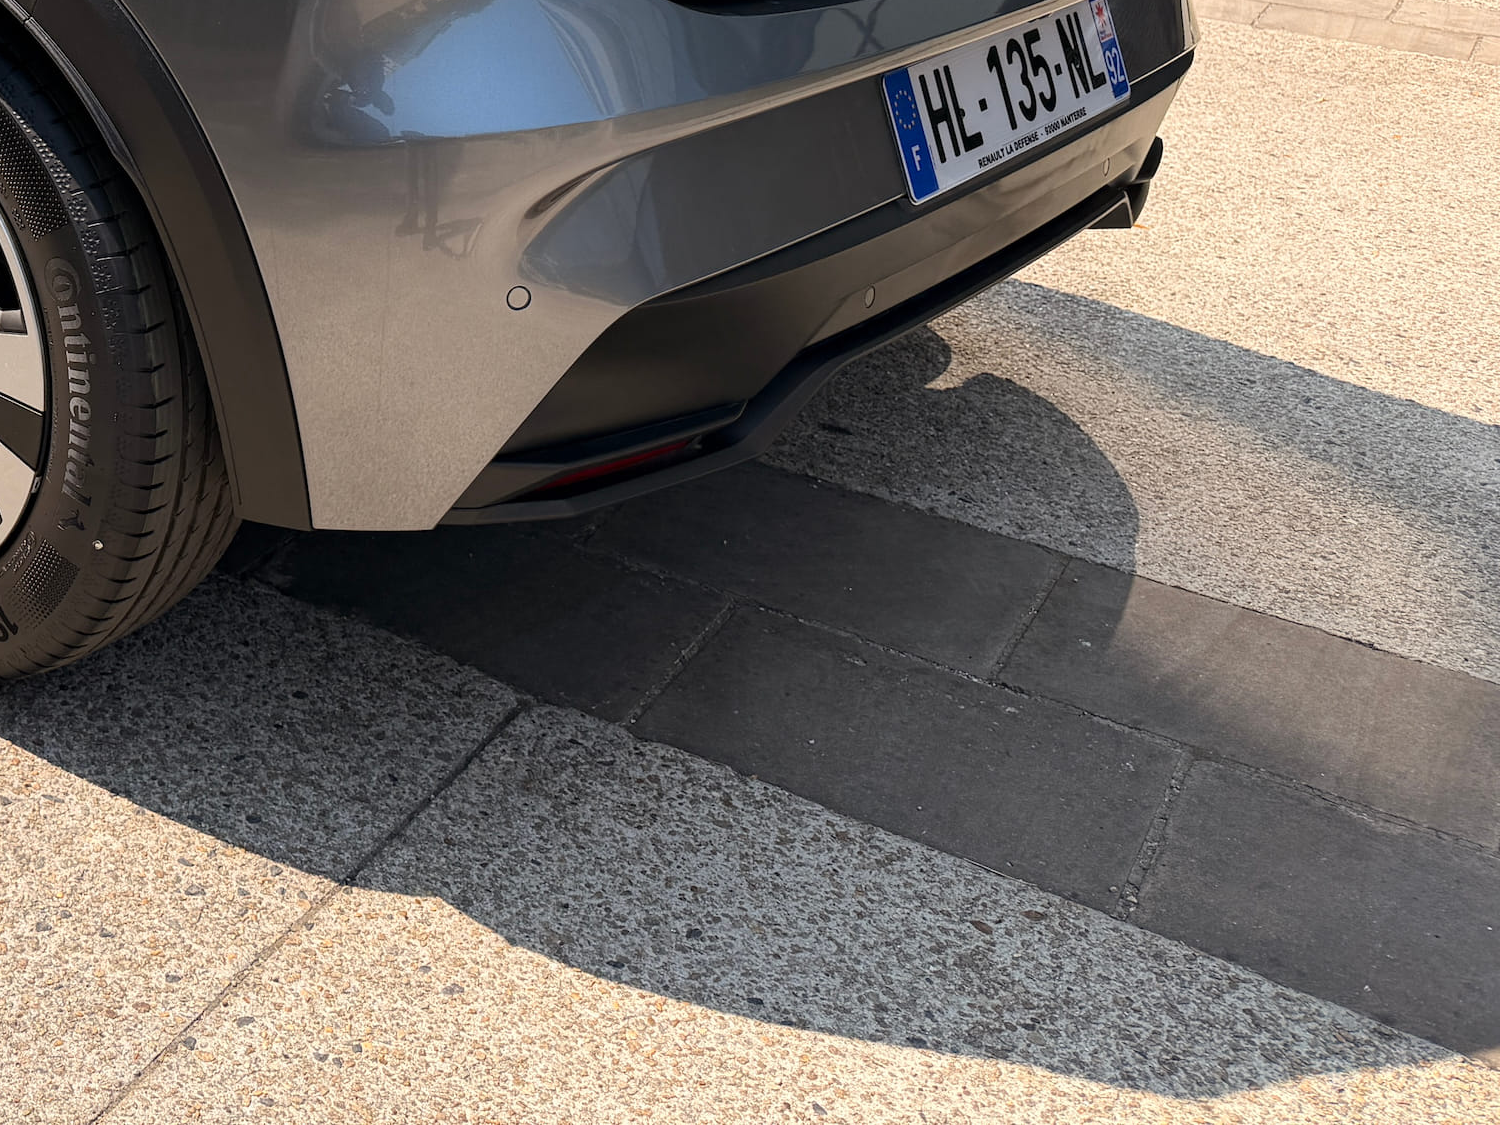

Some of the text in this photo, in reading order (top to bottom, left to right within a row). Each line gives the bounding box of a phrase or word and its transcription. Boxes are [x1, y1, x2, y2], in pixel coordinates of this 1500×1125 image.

[1105, 47, 1126, 85] 92
[977, 147, 1006, 169] RENAULT
[1005, 144, 1015, 155] LA
[1014, 131, 1040, 151] DEFENSE
[1044, 122, 1061, 136] 92000
[1060, 106, 1087, 127] NANTERRE
[911, 144, 922, 172] F
